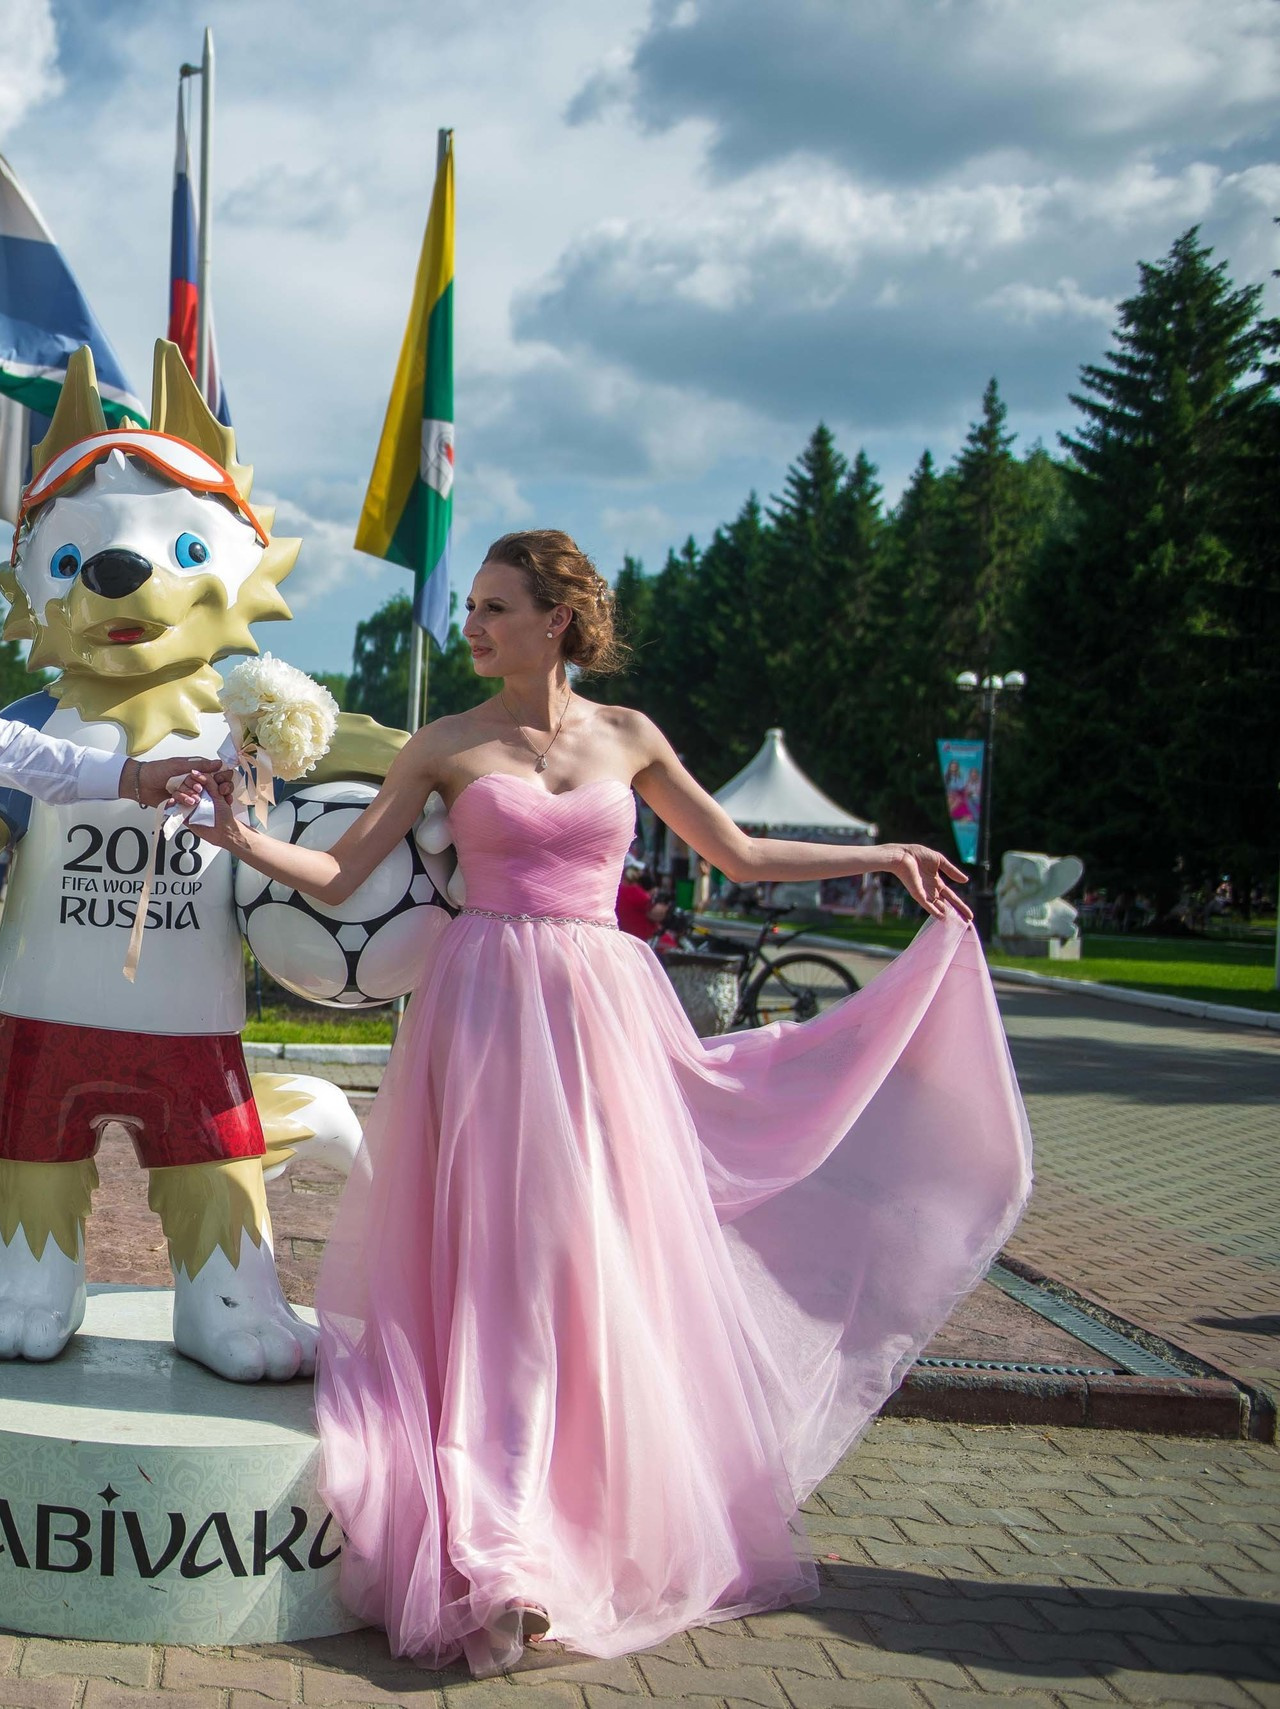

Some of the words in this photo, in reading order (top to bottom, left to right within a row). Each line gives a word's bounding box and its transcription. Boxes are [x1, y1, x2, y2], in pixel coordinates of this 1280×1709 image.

[63, 823, 203, 877] 2018
[61, 876, 98, 892] FIFA
[103, 879, 167, 895] WORD
[170, 881, 202, 896] CUP
[59, 895, 201, 930] RUSSIA
